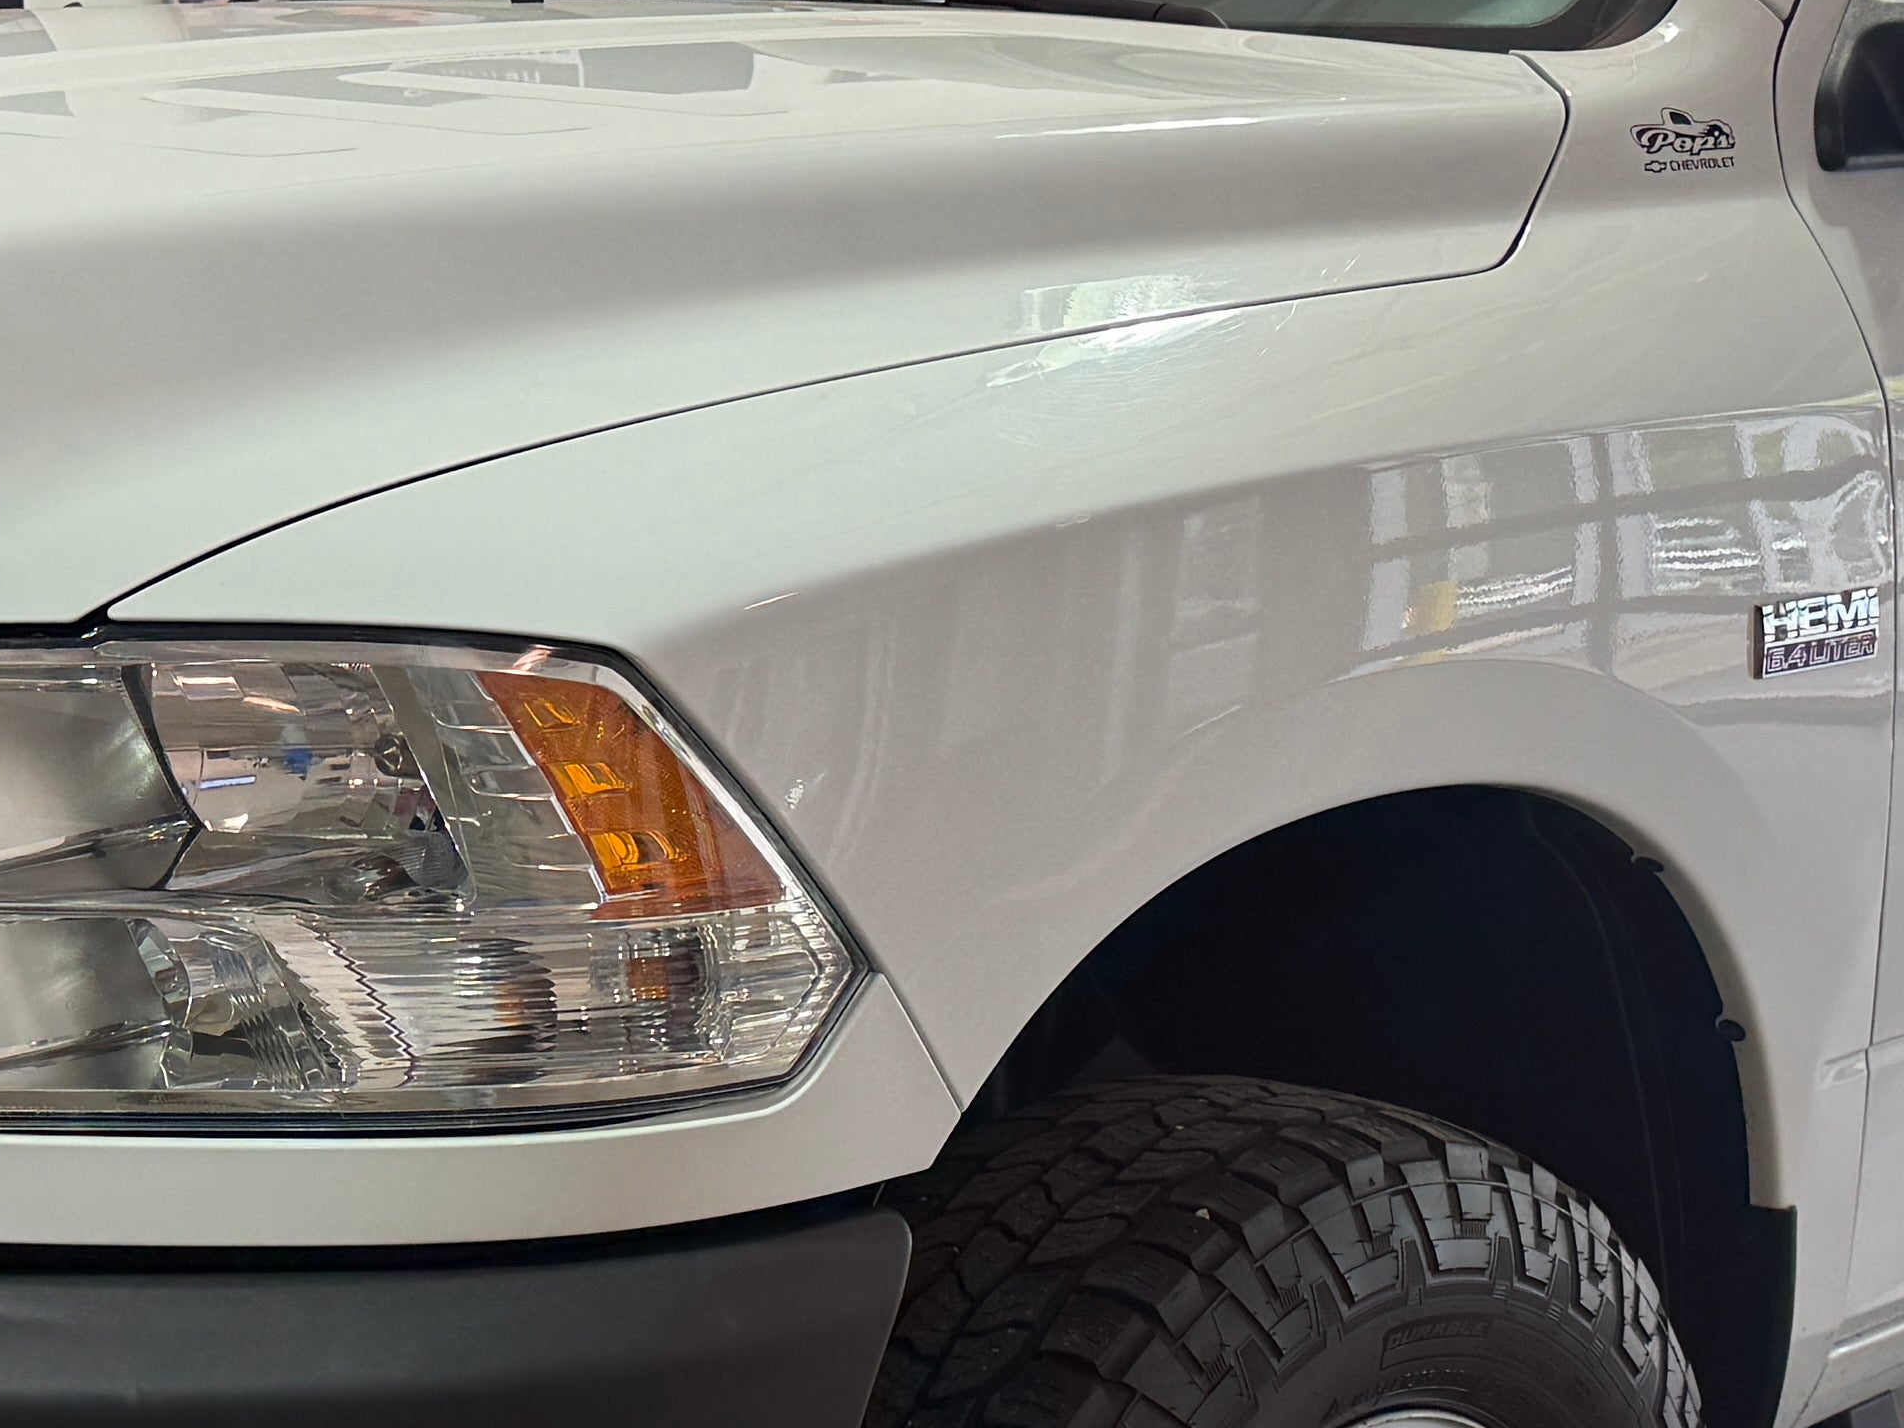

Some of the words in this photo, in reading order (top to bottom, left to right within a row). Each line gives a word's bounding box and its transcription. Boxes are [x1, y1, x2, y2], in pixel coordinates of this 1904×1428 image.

[1669, 156, 1735, 172] CHEVROLET
[1761, 586, 1879, 644] HEMI
[1809, 633, 1875, 666] LITER
